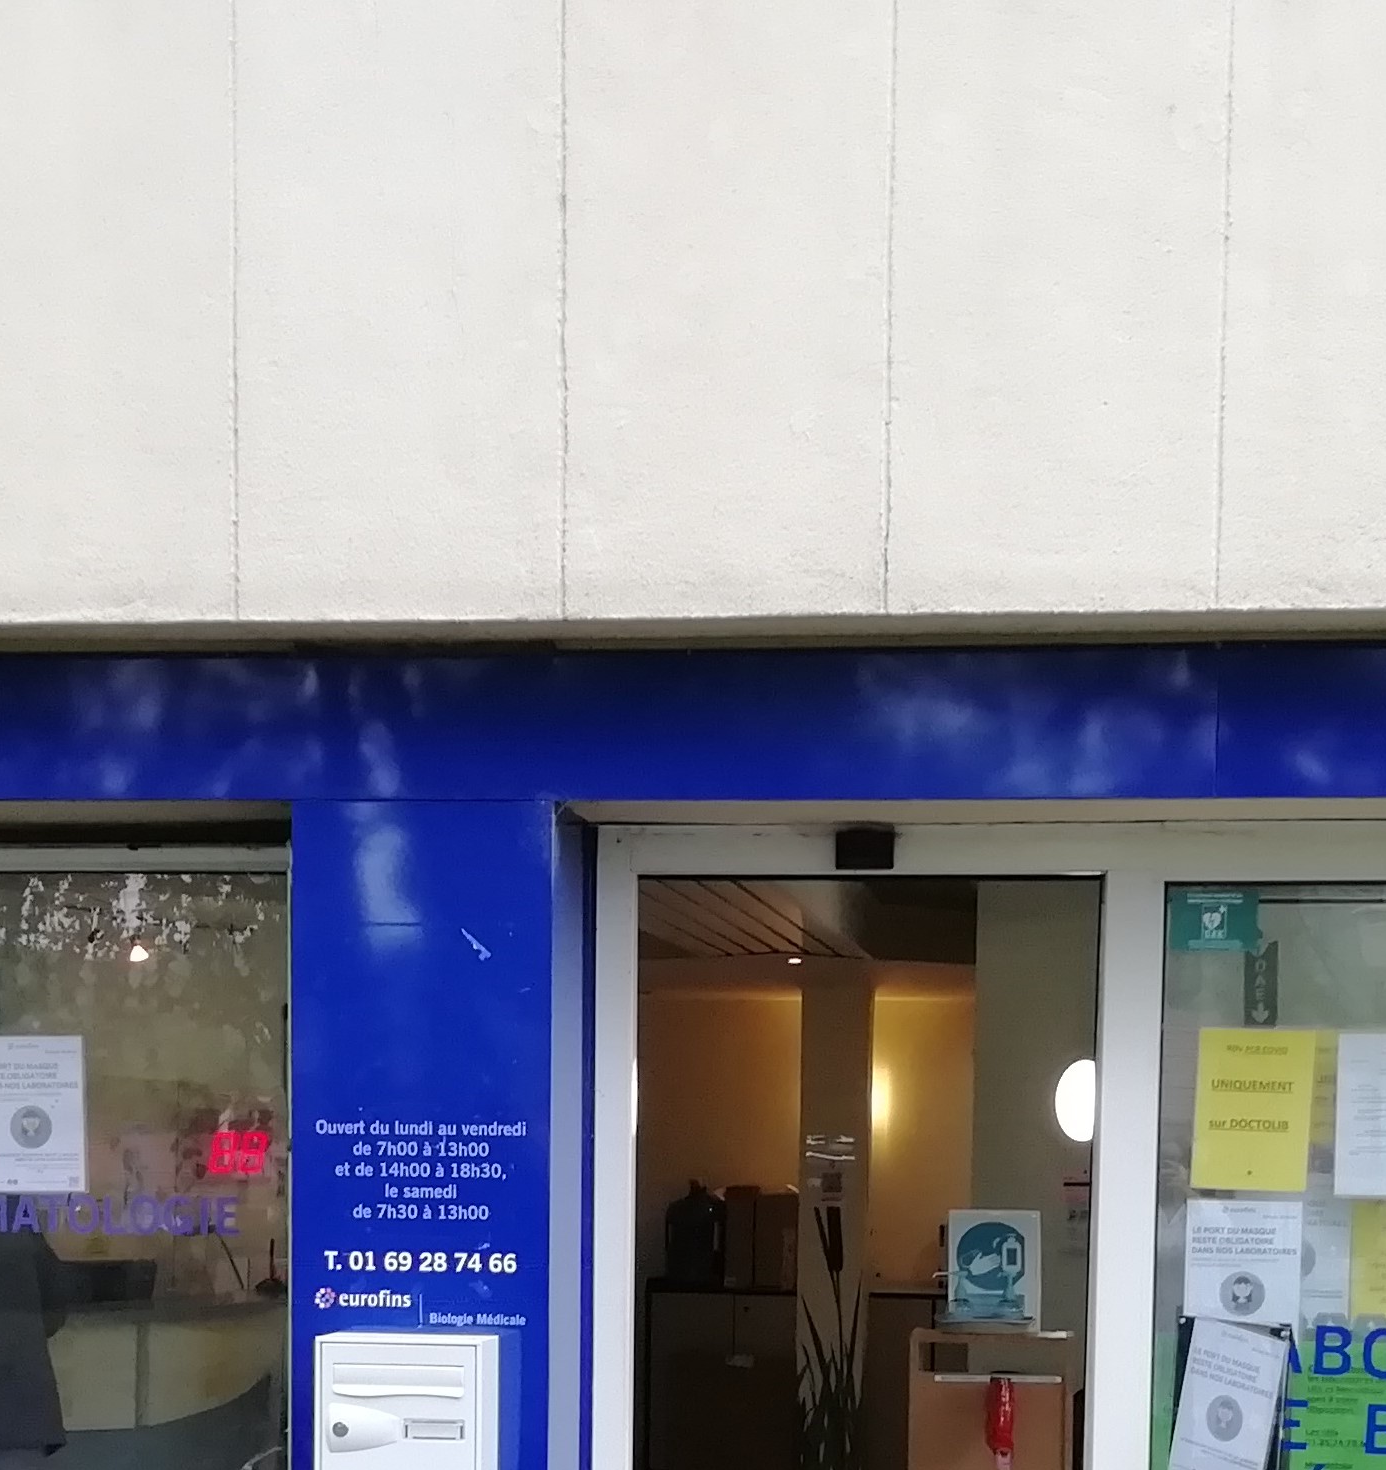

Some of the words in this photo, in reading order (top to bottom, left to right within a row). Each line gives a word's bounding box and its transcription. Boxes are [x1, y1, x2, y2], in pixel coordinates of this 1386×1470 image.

[1211, 1079, 1295, 1092] UNIQUEMENT
[315, 1119, 364, 1135] Ouvert
[370, 1120, 389, 1135] du
[394, 1120, 433, 1135] lundi
[438, 1124, 456, 1136] au
[461, 1121, 527, 1137] vendredi
[1208, 1120, 1226, 1129] sur
[1229, 1118, 1290, 1131] DOCTOLIB
[353, 1141, 371, 1156] de
[376, 1141, 418, 1156] 7h00
[422, 1141, 432, 1157] à
[438, 1142, 489, 1157] 13h00
[335, 1163, 350, 1177] et
[355, 1162, 374, 1177] de
[380, 1162, 430, 1177] 14h00
[435, 1162, 445, 1178] à
[451, 1163, 507, 1180] 18h30,
[384, 1183, 398, 1198] le
[403, 1184, 457, 1199] samedi
[353, 1204, 371, 1219] de
[376, 1204, 418, 1219] 7h30
[422, 1204, 432, 1220] à
[438, 1205, 489, 1220] 13h00
[1241, 1227, 1277, 1236] MASQUE
[1191, 1246, 1214, 1254] DANS
[1216, 1246, 1233, 1255] NOS
[1235, 1247, 1298, 1256] LABORATOIRES
[324, 1251, 342, 1270] T.
[348, 1251, 376, 1270] 01
[384, 1252, 412, 1271] 69
[419, 1252, 447, 1272] 28
[454, 1253, 482, 1272] 74
[488, 1253, 517, 1273] 66
[339, 1290, 412, 1308] eurofins
[429, 1312, 473, 1327] Biologie
[476, 1313, 526, 1326] Médicale
